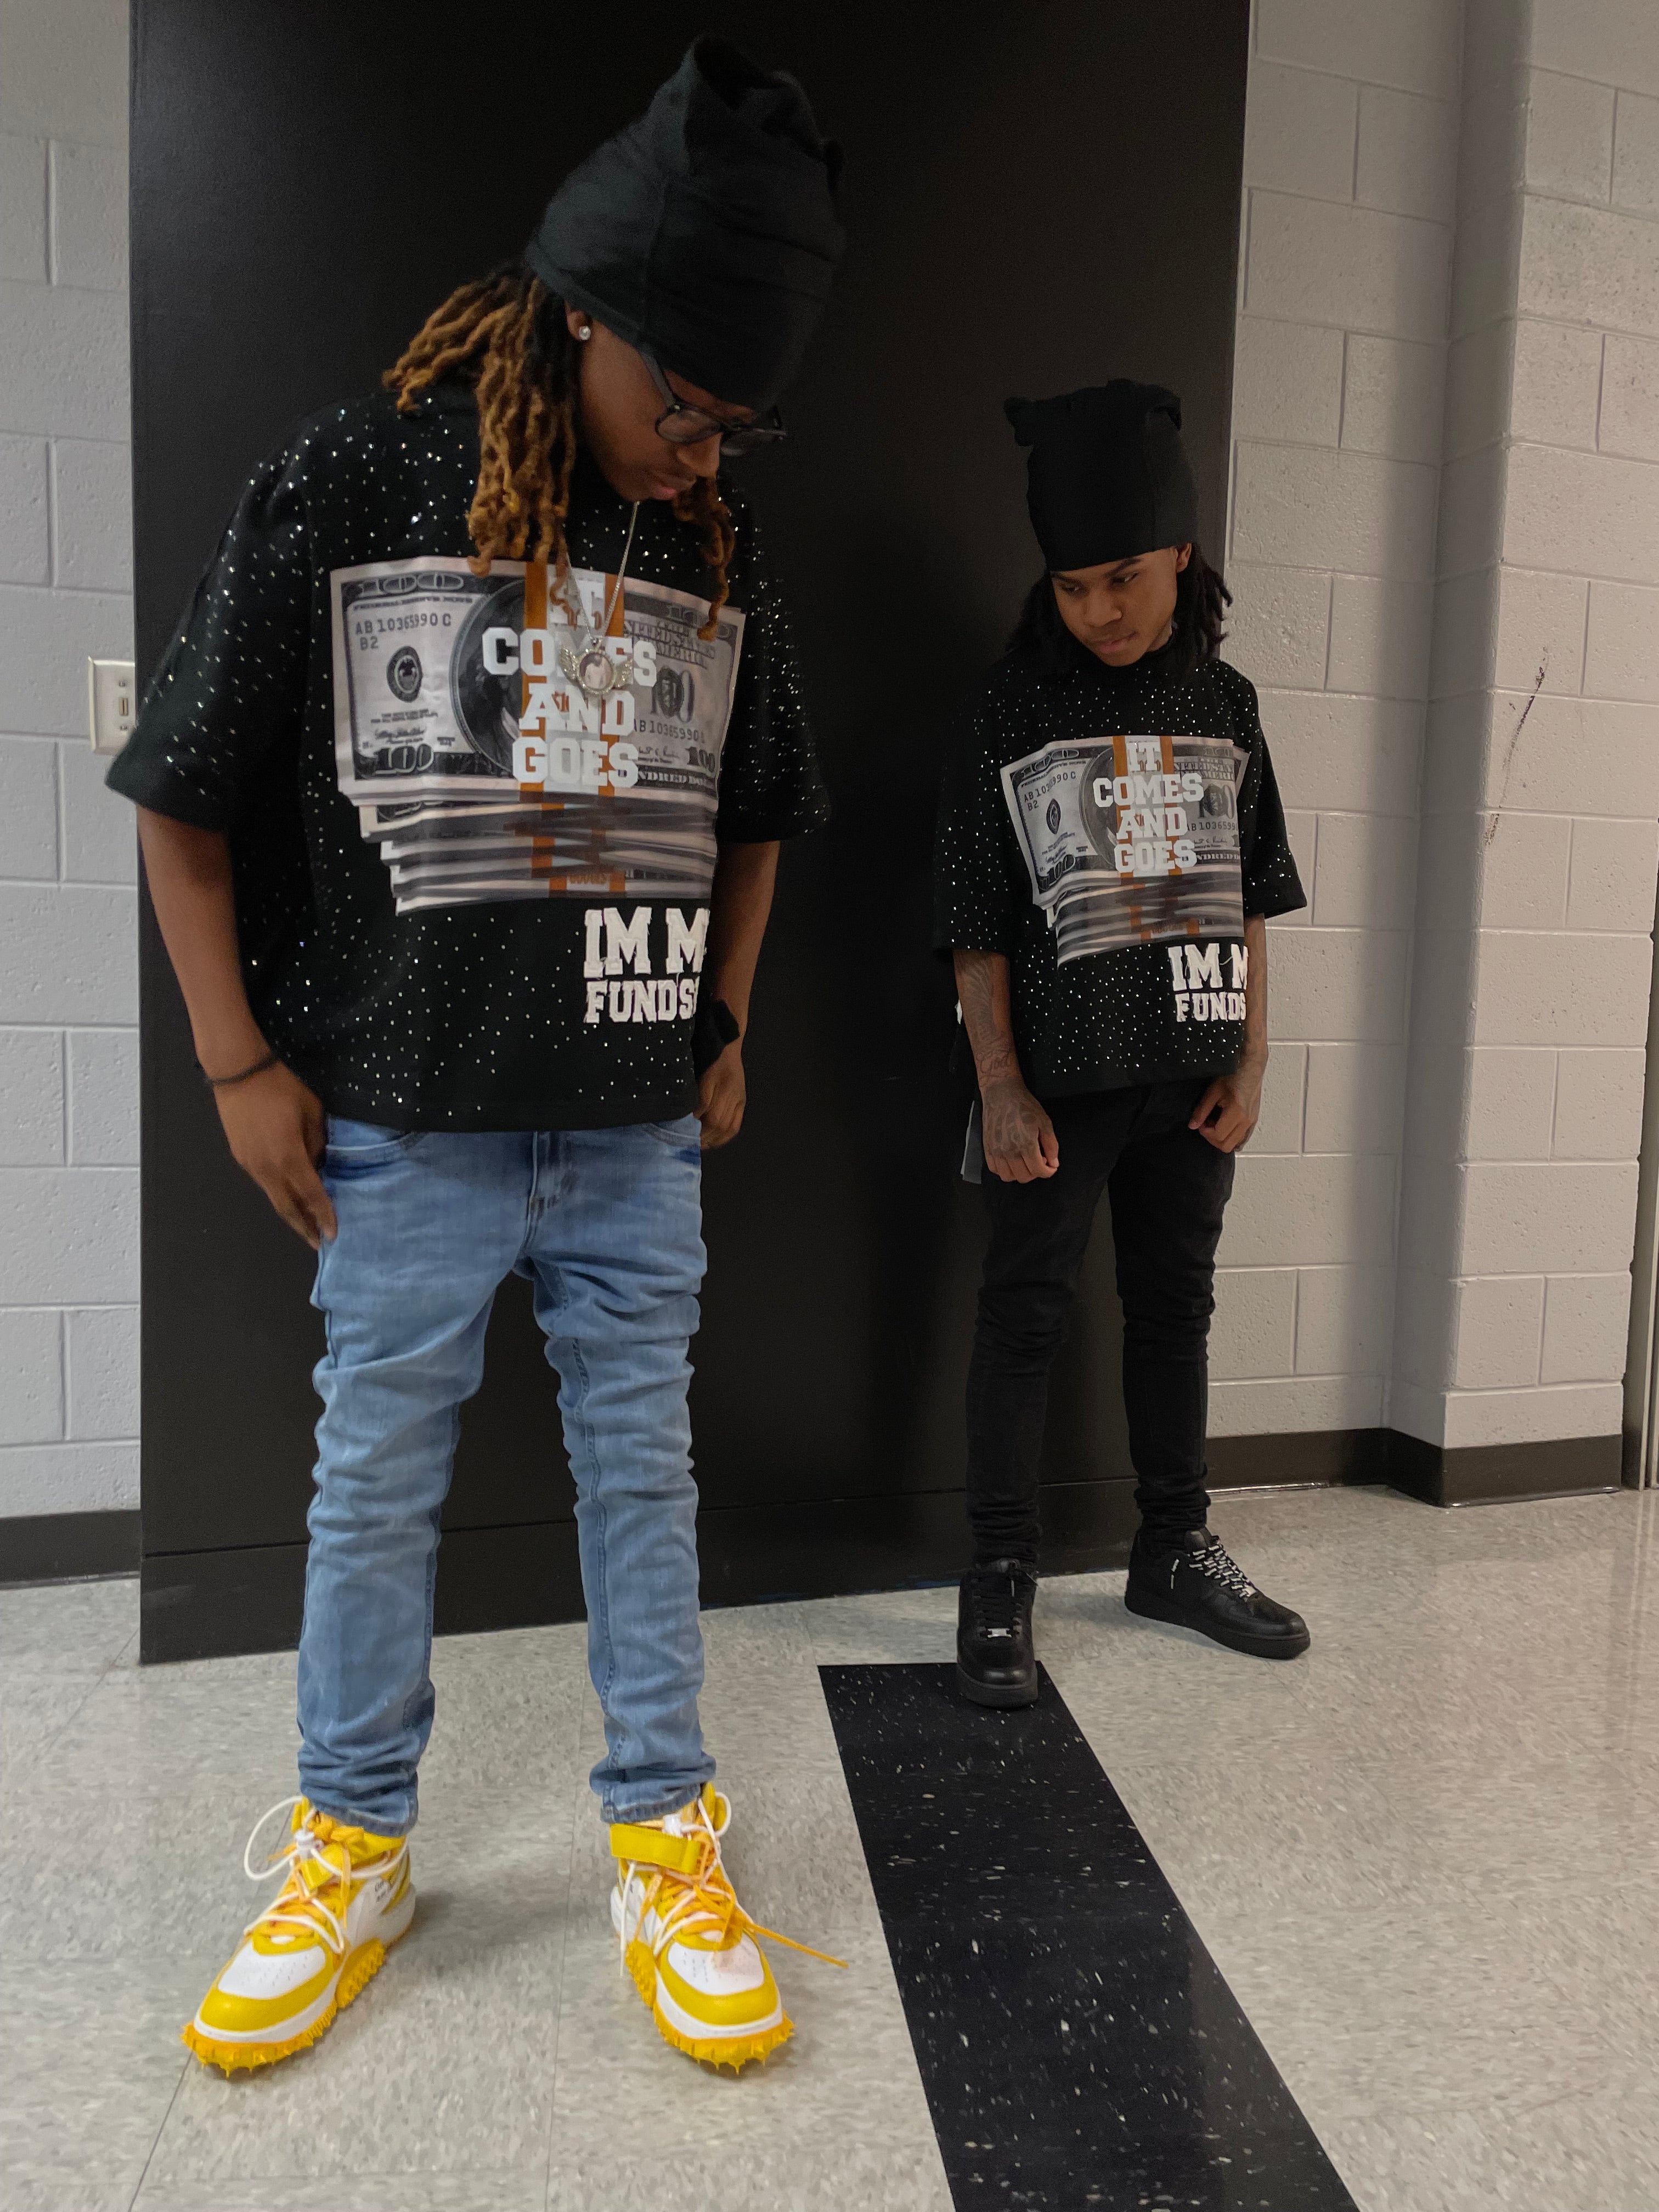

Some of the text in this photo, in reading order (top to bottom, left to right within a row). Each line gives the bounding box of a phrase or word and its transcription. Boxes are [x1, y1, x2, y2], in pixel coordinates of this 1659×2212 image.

[359, 636, 379, 651] B2
[519, 682, 635, 737] AND
[512, 737, 639, 788] GOES
[1125, 742, 1161, 772] IT
[1027, 800, 1039, 811] B2
[1093, 773, 1205, 808] COMES
[1116, 807, 1188, 840] AND
[1114, 839, 1198, 873] GOES
[583, 906, 652, 978] IM
[1168, 943, 1223, 991] IM
[583, 978, 699, 1024] FUNDS
